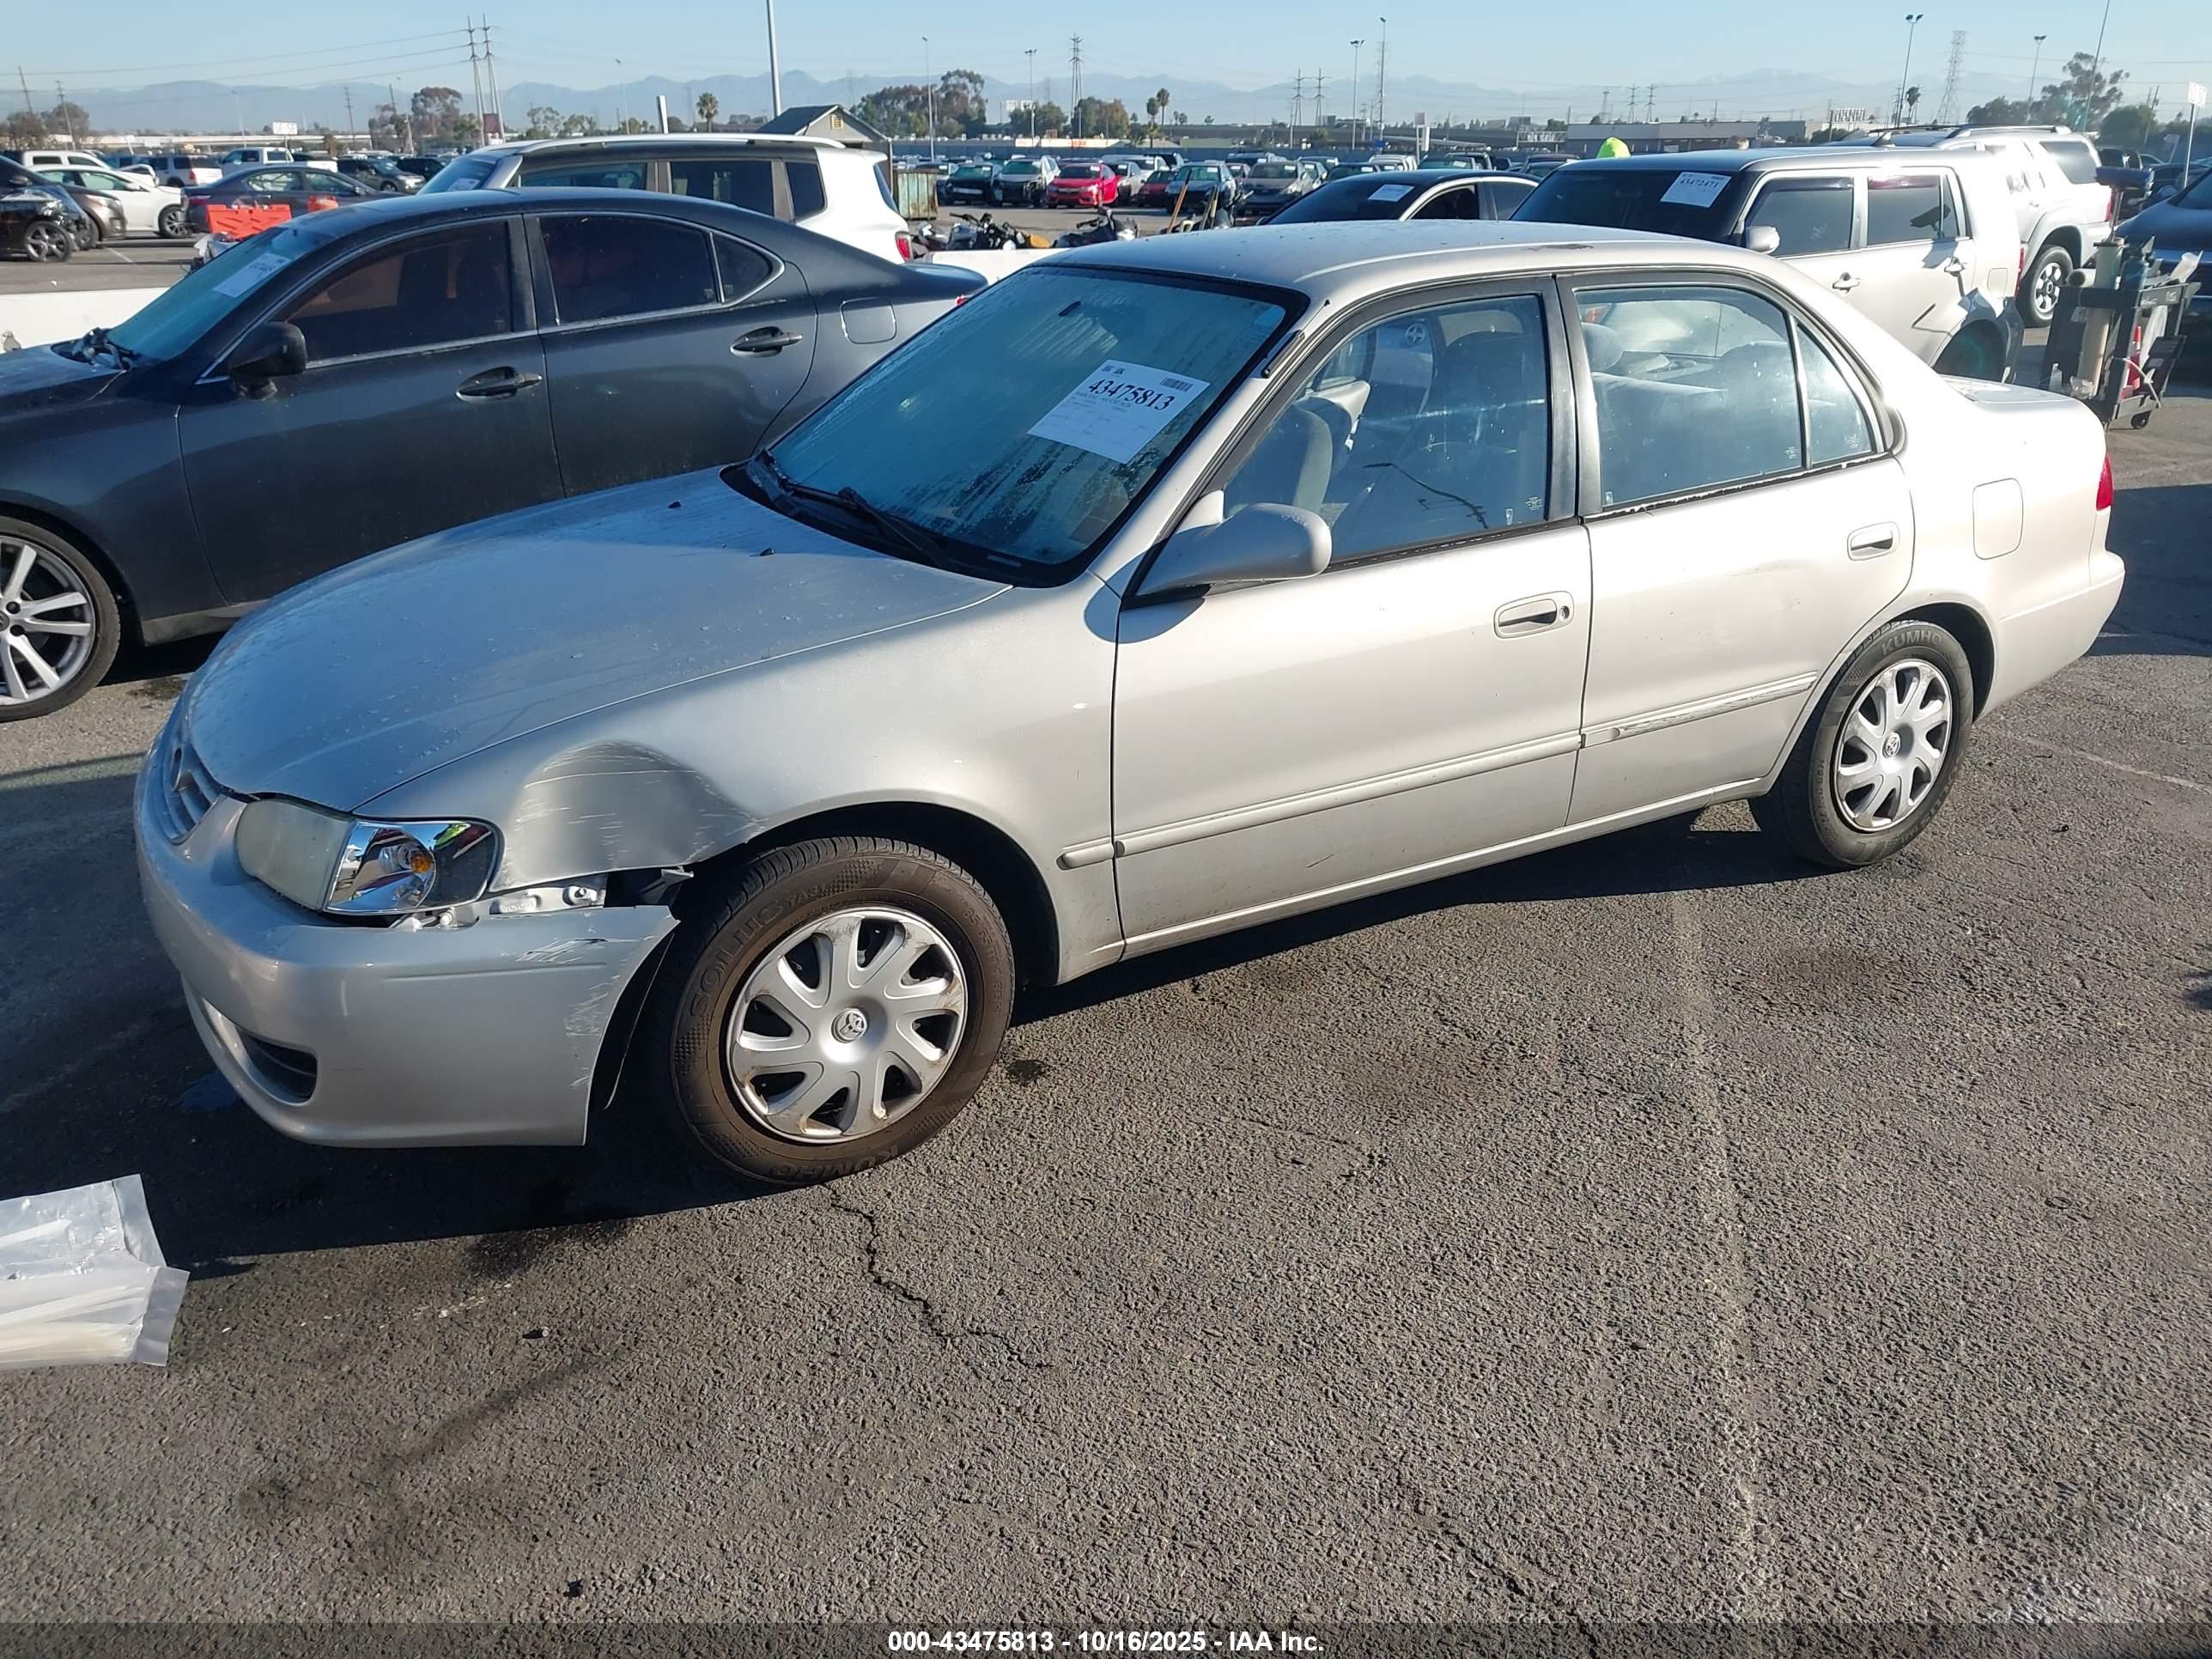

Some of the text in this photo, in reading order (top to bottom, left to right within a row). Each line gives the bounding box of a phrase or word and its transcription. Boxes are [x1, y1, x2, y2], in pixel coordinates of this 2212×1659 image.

[1089, 379, 1176, 410] 43475813
[1881, 629, 1942, 656] KUMHO
[689, 901, 784, 1018] SOLUS
